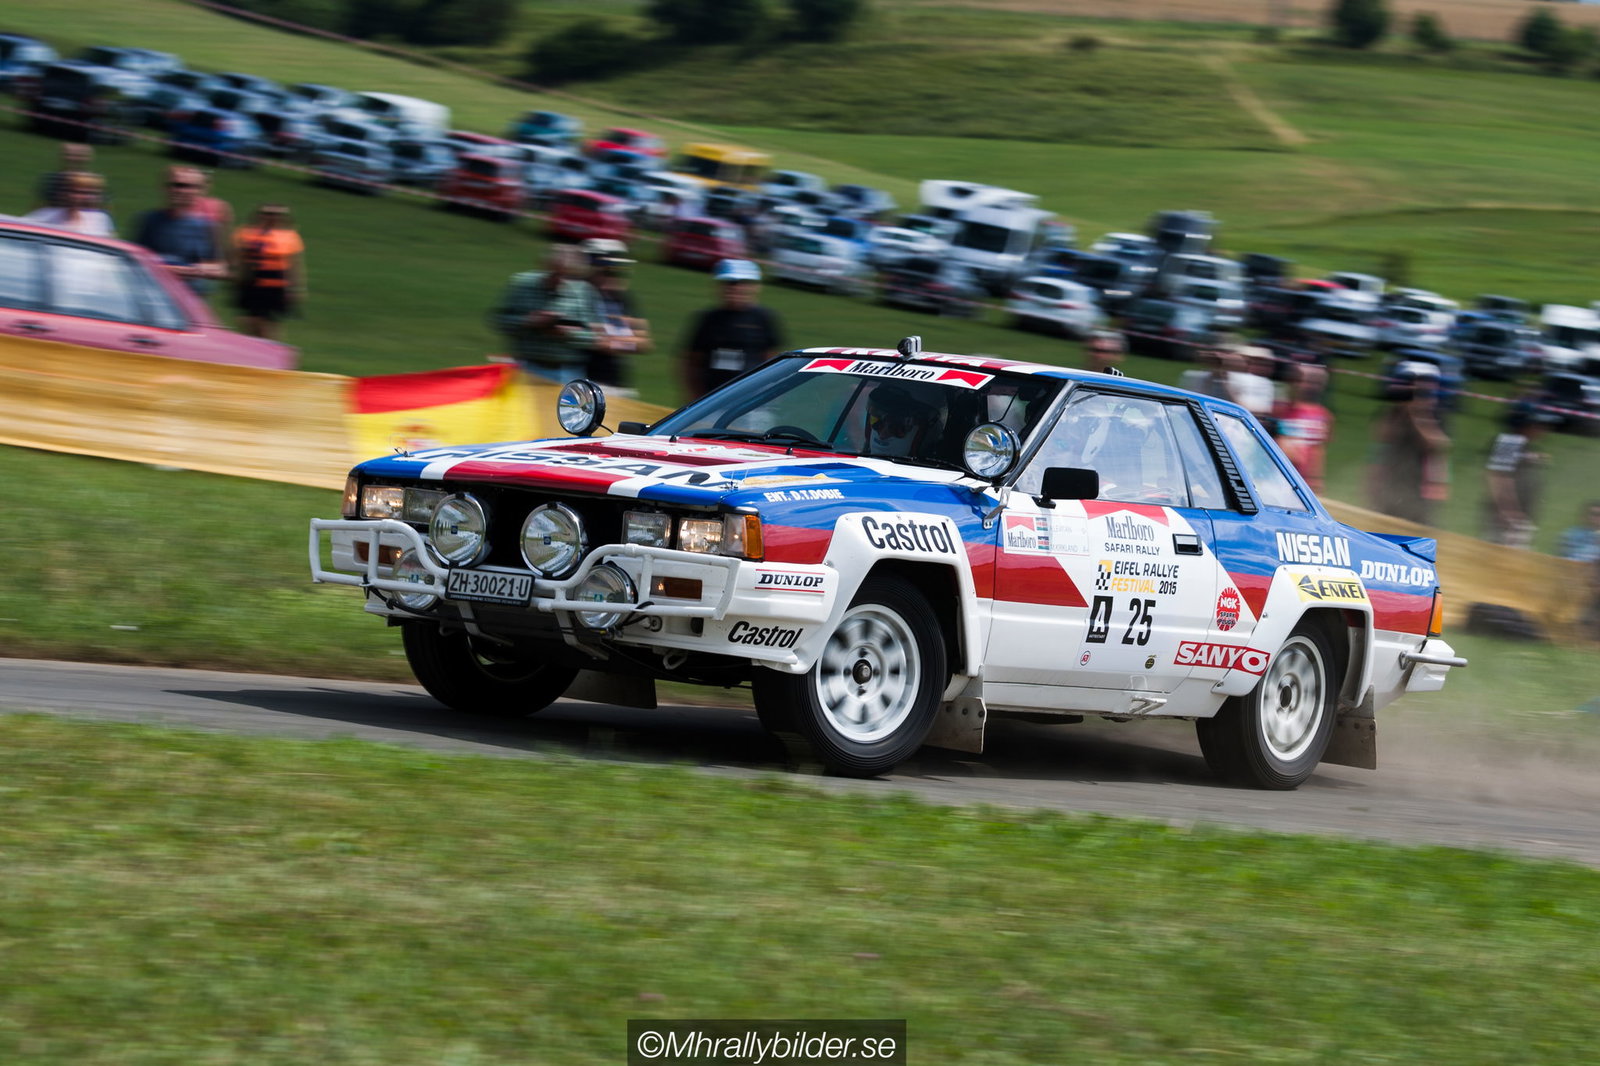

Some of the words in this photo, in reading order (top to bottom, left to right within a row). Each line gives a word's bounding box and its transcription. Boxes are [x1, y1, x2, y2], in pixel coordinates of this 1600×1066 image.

[848, 361, 936, 380] Marlboro
[418, 450, 734, 488] NISSAN
[763, 491, 791, 503] ENT.
[861, 515, 957, 554] Castrol
[1105, 514, 1155, 542] Marlboro
[1007, 531, 1037, 549] Marlboro
[1104, 542, 1134, 554] SAFARI
[1136, 544, 1160, 556] RALLY
[1275, 531, 1351, 566] NISSAN
[1114, 561, 1141, 576] EIFEL
[1143, 562, 1180, 579] RALLYE
[1359, 559, 1435, 587] DUNLOP
[758, 573, 824, 588] DUNLOP
[1111, 577, 1156, 593] FESTIVAL
[1158, 580, 1178, 595] 2015
[1317, 579, 1366, 599] ENKEI
[1219, 597, 1238, 610] NGK
[1121, 597, 1157, 646] 25
[727, 620, 804, 649] Castrol
[1175, 643, 1270, 673] SANYO
